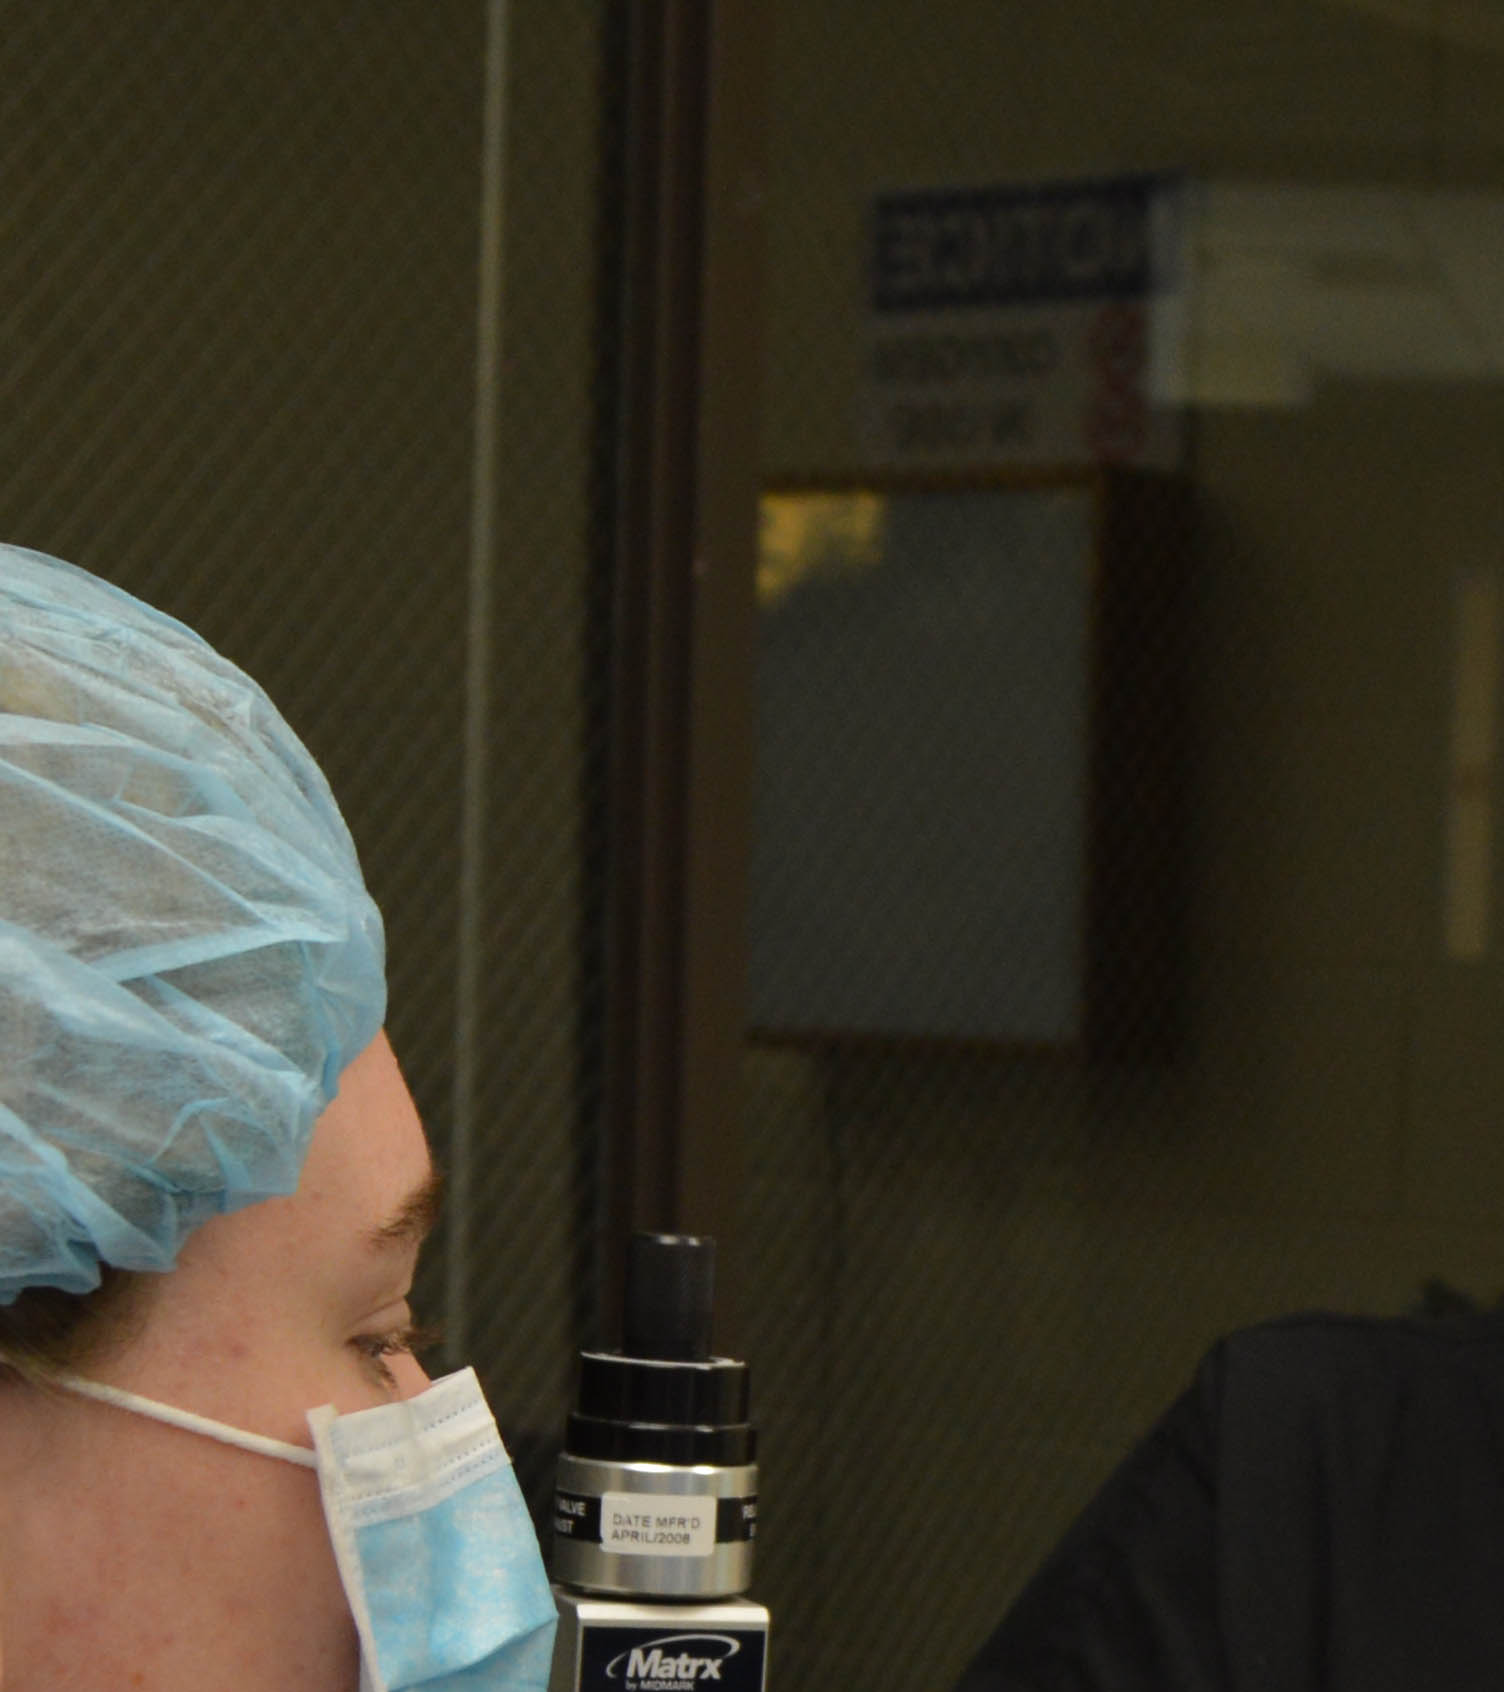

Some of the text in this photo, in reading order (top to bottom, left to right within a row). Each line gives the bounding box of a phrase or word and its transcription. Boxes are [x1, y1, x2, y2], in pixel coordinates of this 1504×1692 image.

[612, 1513, 651, 1527] DATE
[626, 1648, 723, 1680] Matrx
[640, 1680, 694, 1691] MIDMARK
